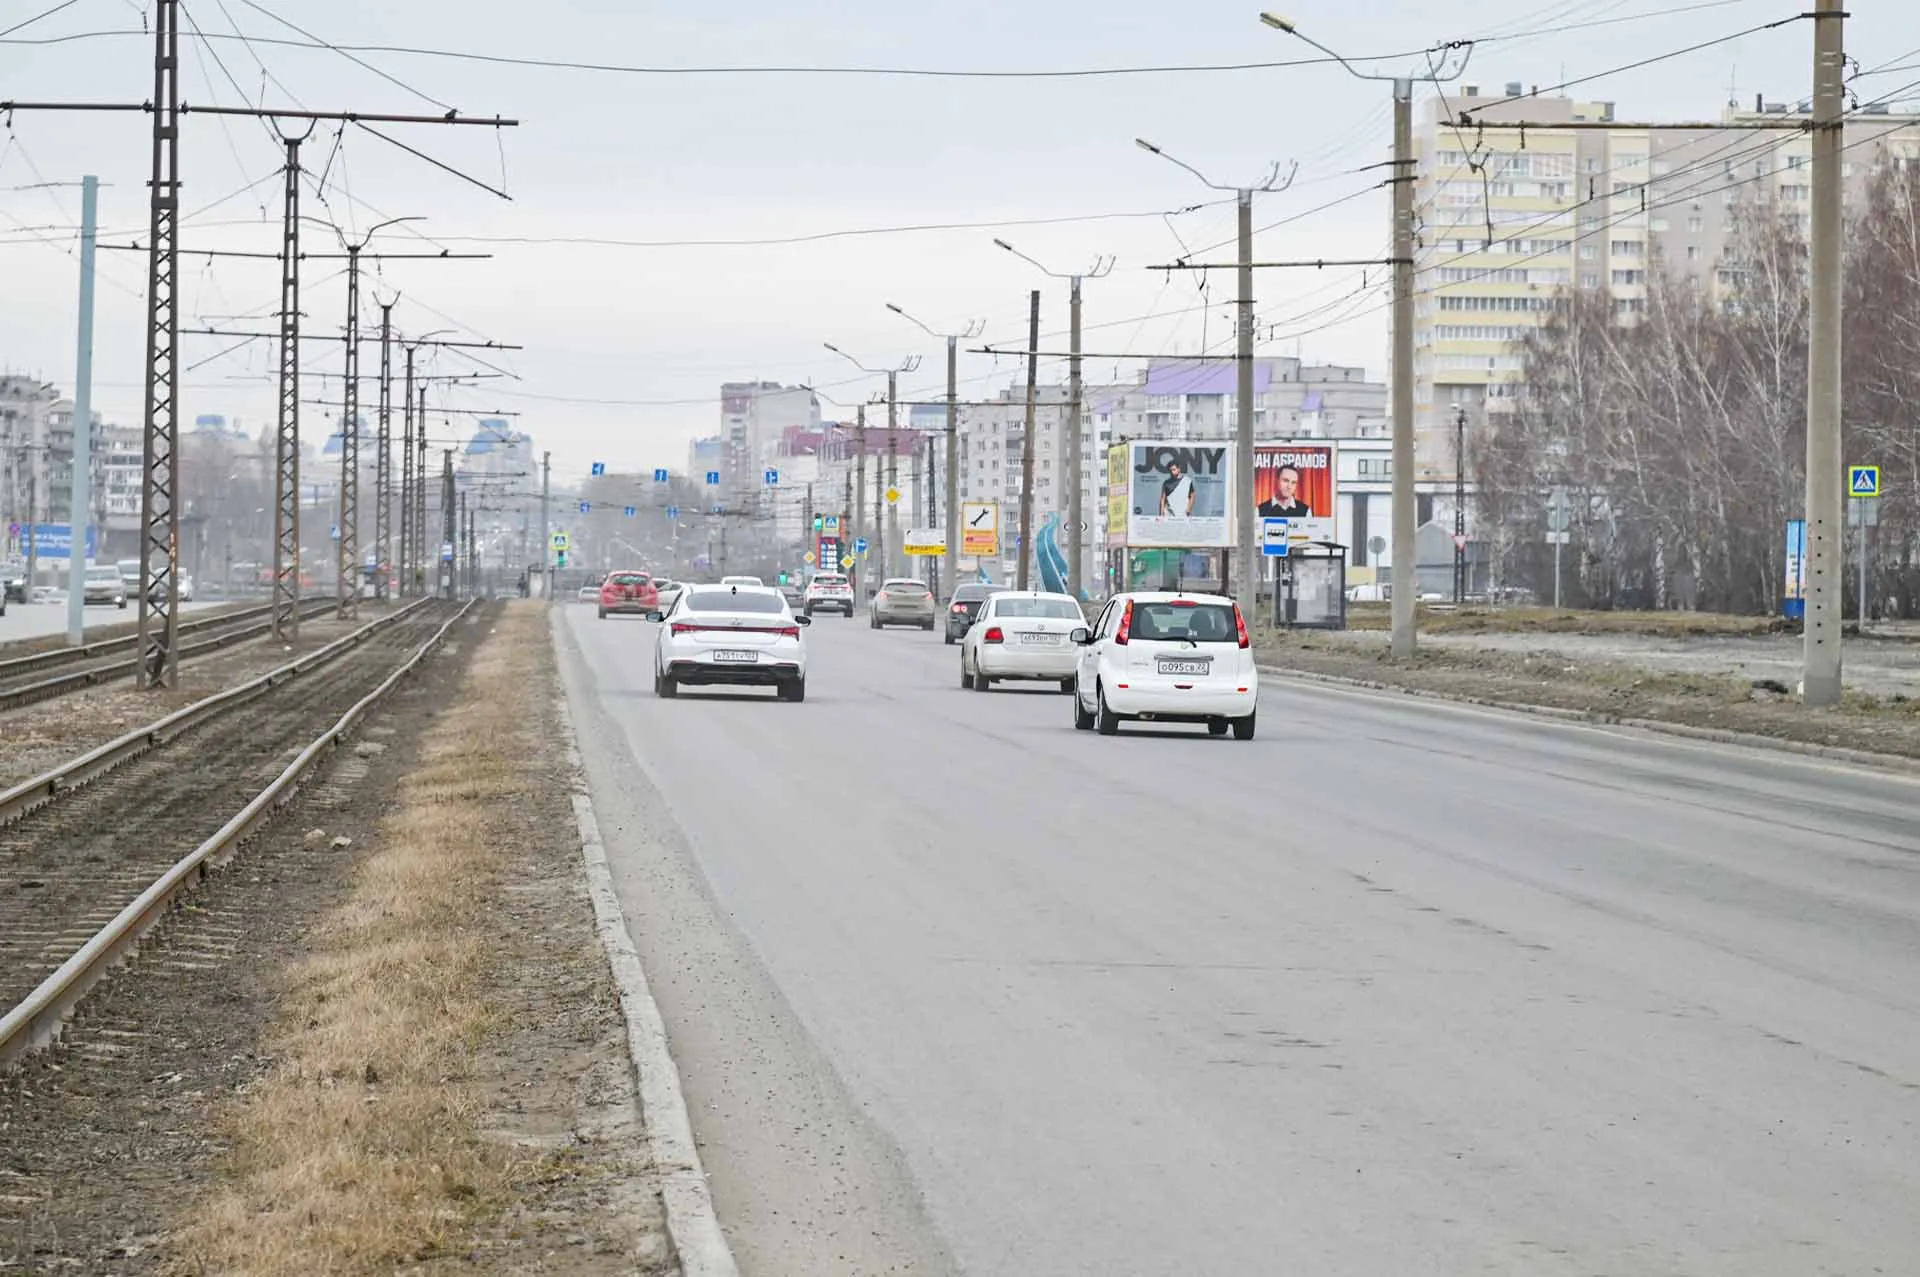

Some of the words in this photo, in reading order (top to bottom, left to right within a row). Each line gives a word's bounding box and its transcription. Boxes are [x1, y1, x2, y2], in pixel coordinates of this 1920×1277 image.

[1134, 446, 1226, 474] JONY
[1254, 453, 1271, 468] АН
[1272, 453, 1327, 469] АБРАМОВ
